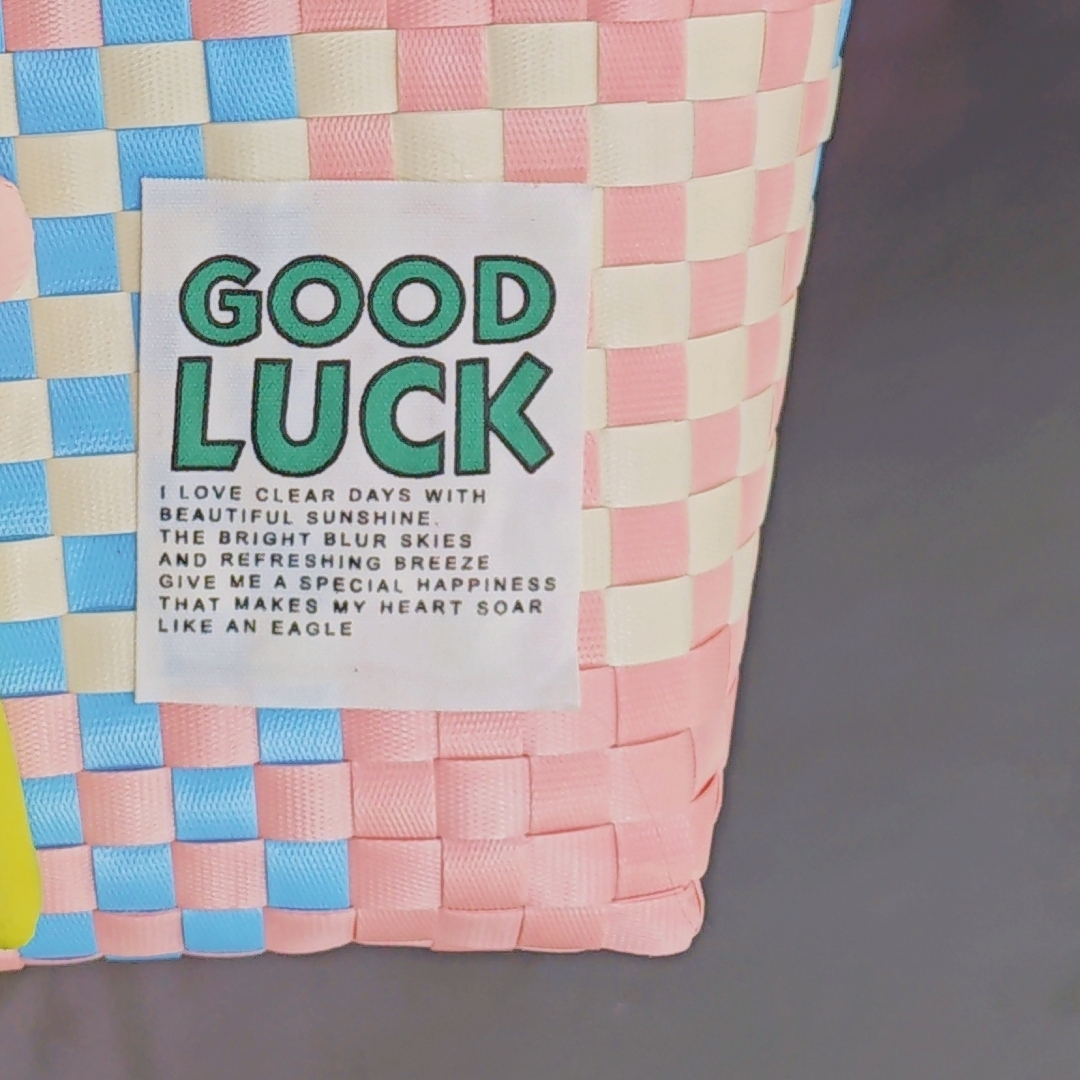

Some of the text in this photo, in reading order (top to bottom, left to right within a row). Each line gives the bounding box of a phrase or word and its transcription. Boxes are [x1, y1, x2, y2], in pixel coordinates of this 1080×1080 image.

[178, 254, 557, 348] GOOD
[170, 351, 554, 478] LUCK
[160, 485, 486, 504] I LOVE CLEAR DAYS WITH
[160, 507, 293, 525] BEAUTIFUL
[159, 529, 472, 549] THE BRIGHT BLUR SKIES
[159, 552, 490, 571] AND REFRESHING BREEZE
[159, 574, 557, 594] GIVE ME A SPECIAL HAPPINESS
[159, 596, 543, 616] THAT MAKES MY HEART SOAR
[158, 618, 352, 637] LIKE AN EAGLE
